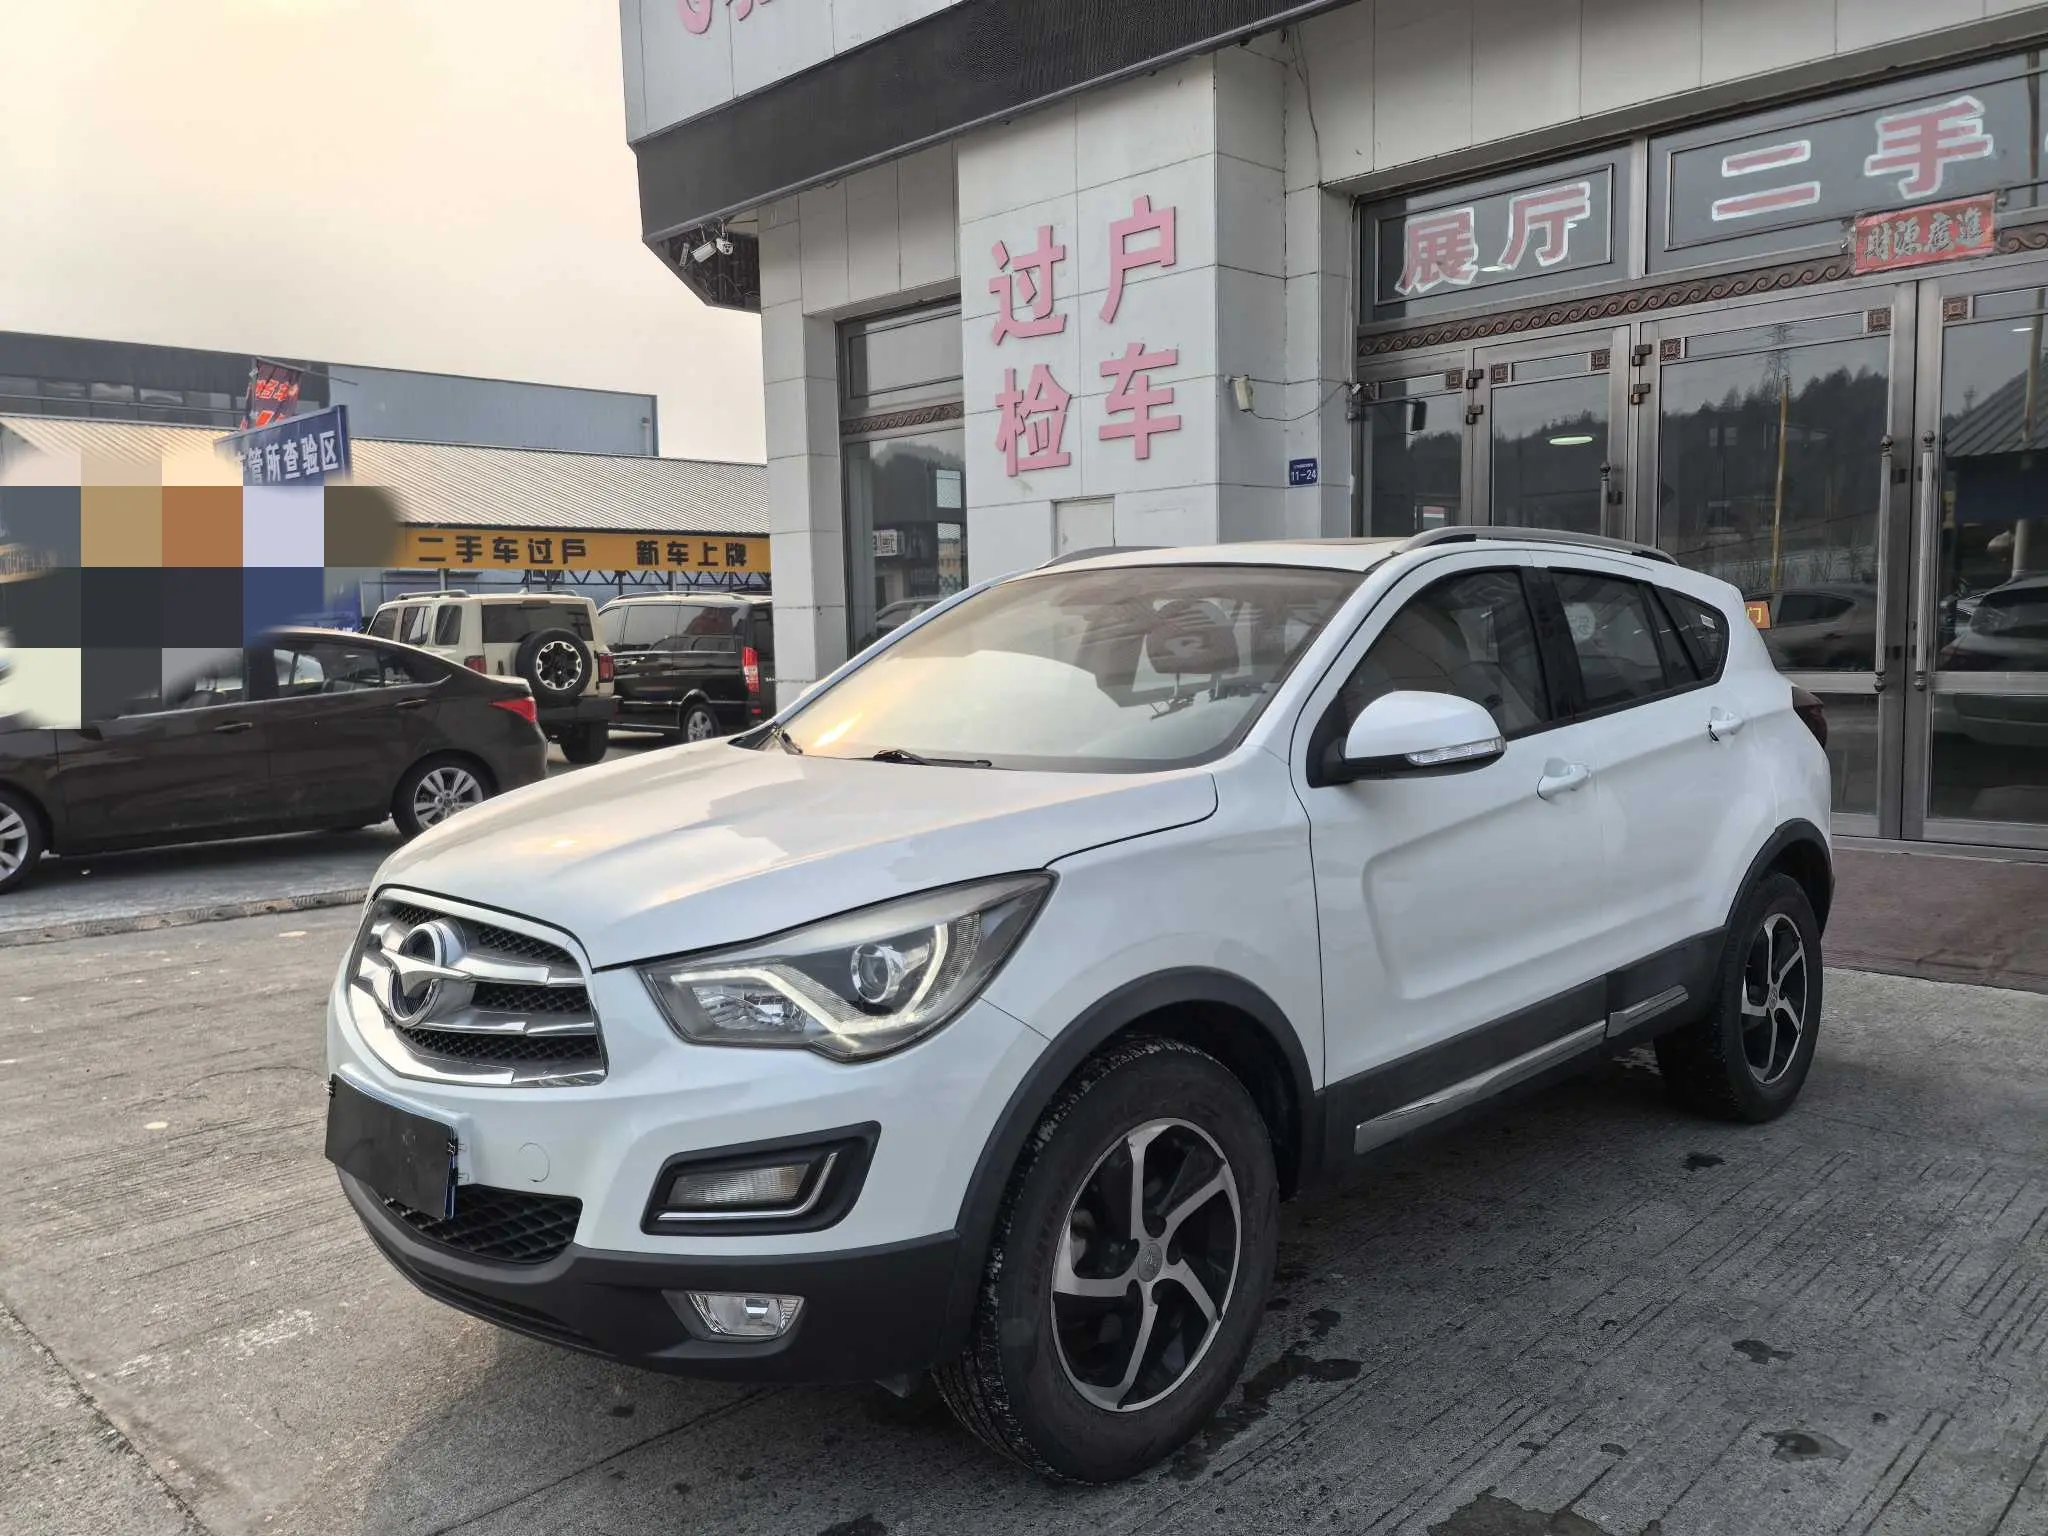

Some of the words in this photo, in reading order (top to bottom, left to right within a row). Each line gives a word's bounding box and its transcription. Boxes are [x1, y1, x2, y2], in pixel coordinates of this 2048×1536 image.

[1396, 181, 1590, 293] 展厅
[1712, 95, 1993, 221] 二手
[989, 195, 1176, 346] 过户
[995, 343, 1181, 477] 检车
[418, 535, 586, 565] 二手车过户
[636, 540, 748, 567] 新车上牌
